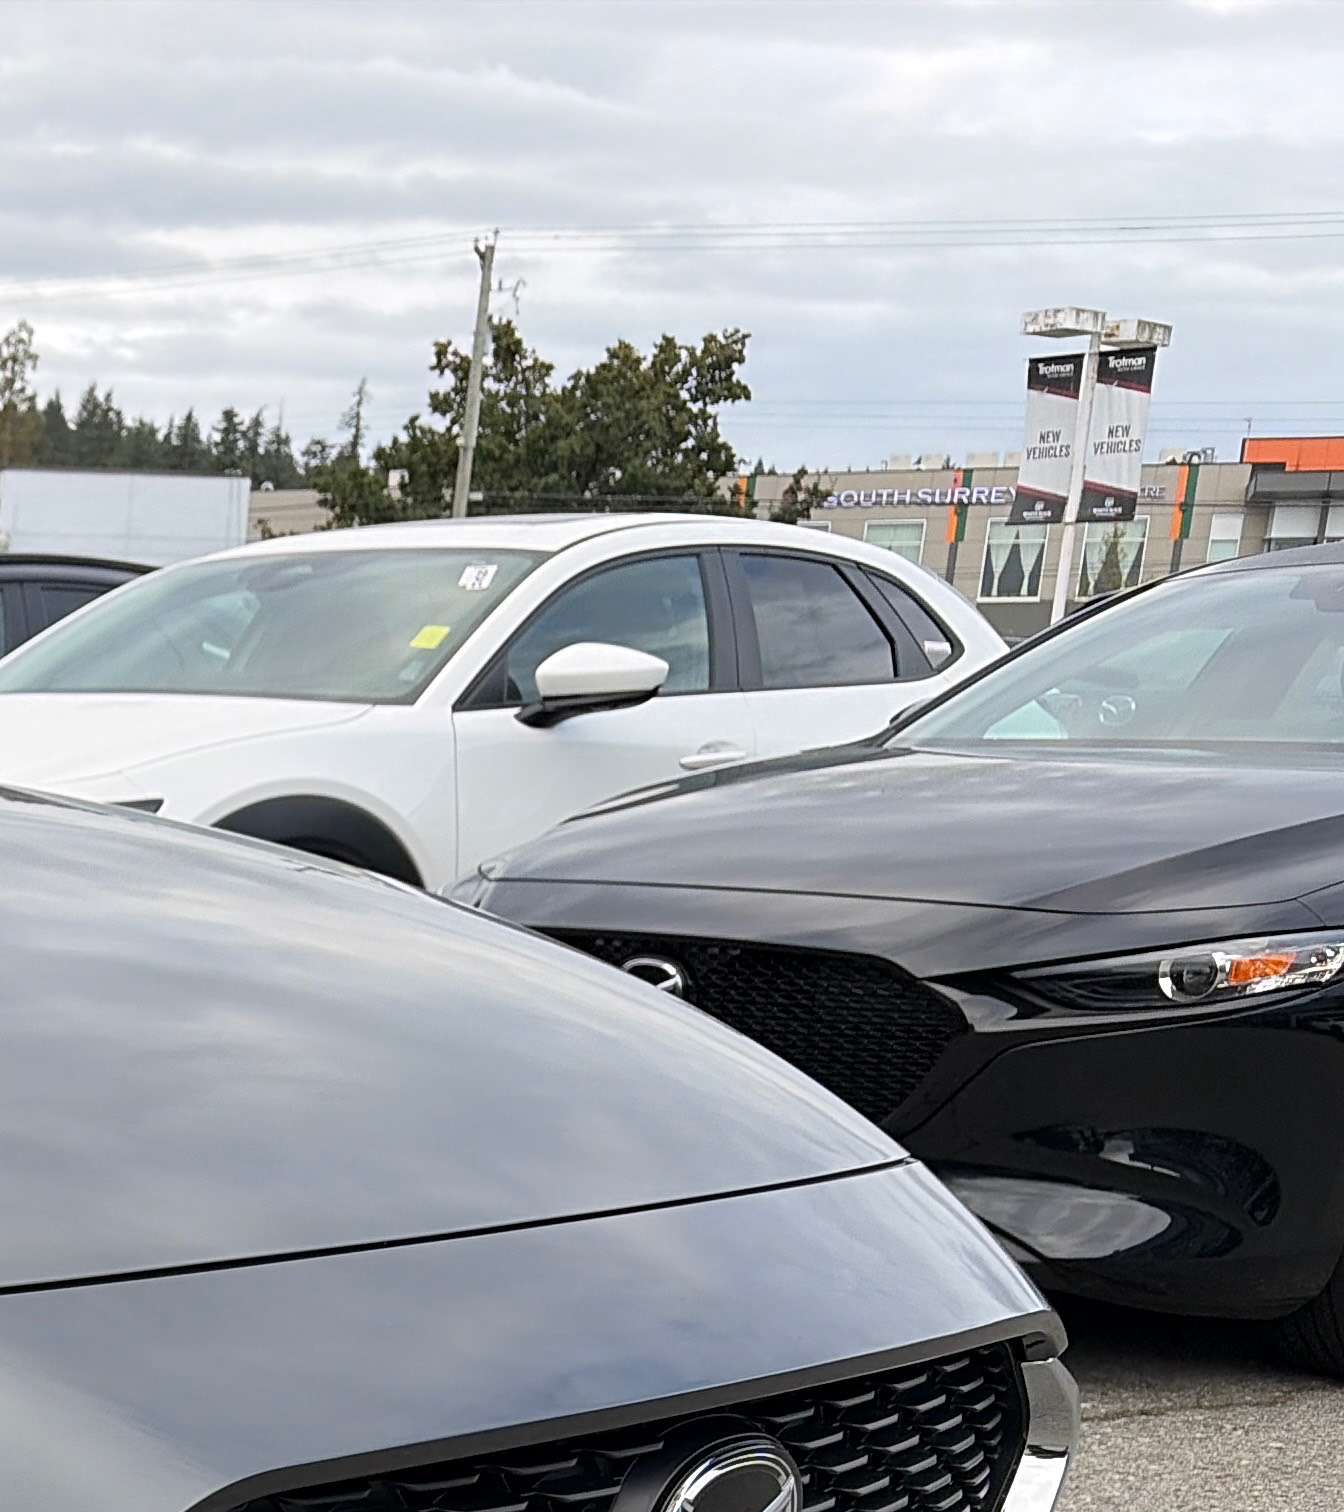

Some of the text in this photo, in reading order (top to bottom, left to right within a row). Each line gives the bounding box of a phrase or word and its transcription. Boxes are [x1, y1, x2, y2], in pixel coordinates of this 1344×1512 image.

[1108, 355, 1147, 369] Trotman
[1039, 428, 1062, 445] NEW
[1107, 424, 1132, 439] NEW
[1026, 444, 1071, 460] VEHICLES
[1093, 439, 1142, 456] VEHICLES
